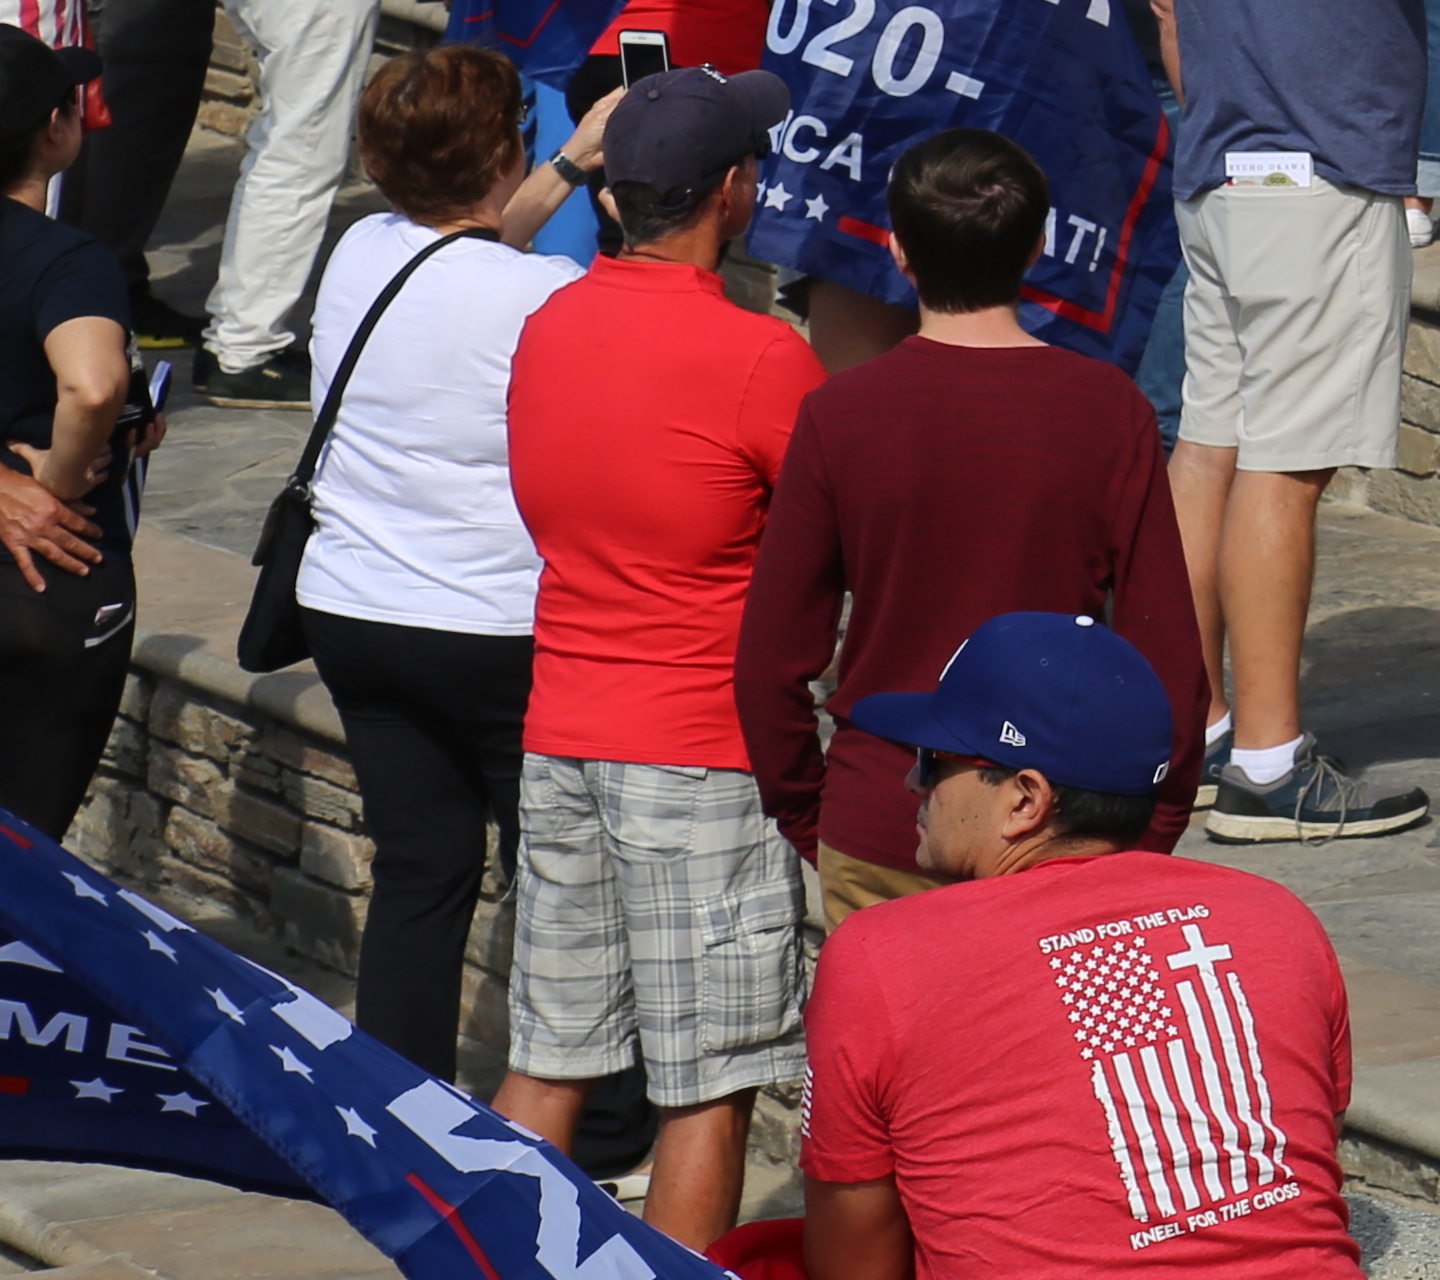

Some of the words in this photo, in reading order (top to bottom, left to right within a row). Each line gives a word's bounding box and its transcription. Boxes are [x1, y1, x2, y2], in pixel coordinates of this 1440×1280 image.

[1038, 927, 1095, 955] STAND
[1099, 919, 1133, 940] FOR
[1133, 912, 1167, 932] THE
[1169, 904, 1211, 925] FLAG
[1129, 1225, 1186, 1251] KNEEL
[1187, 1213, 1220, 1232] FOR
[1220, 1202, 1252, 1223] THE
[1253, 1183, 1301, 1210] CROSS
